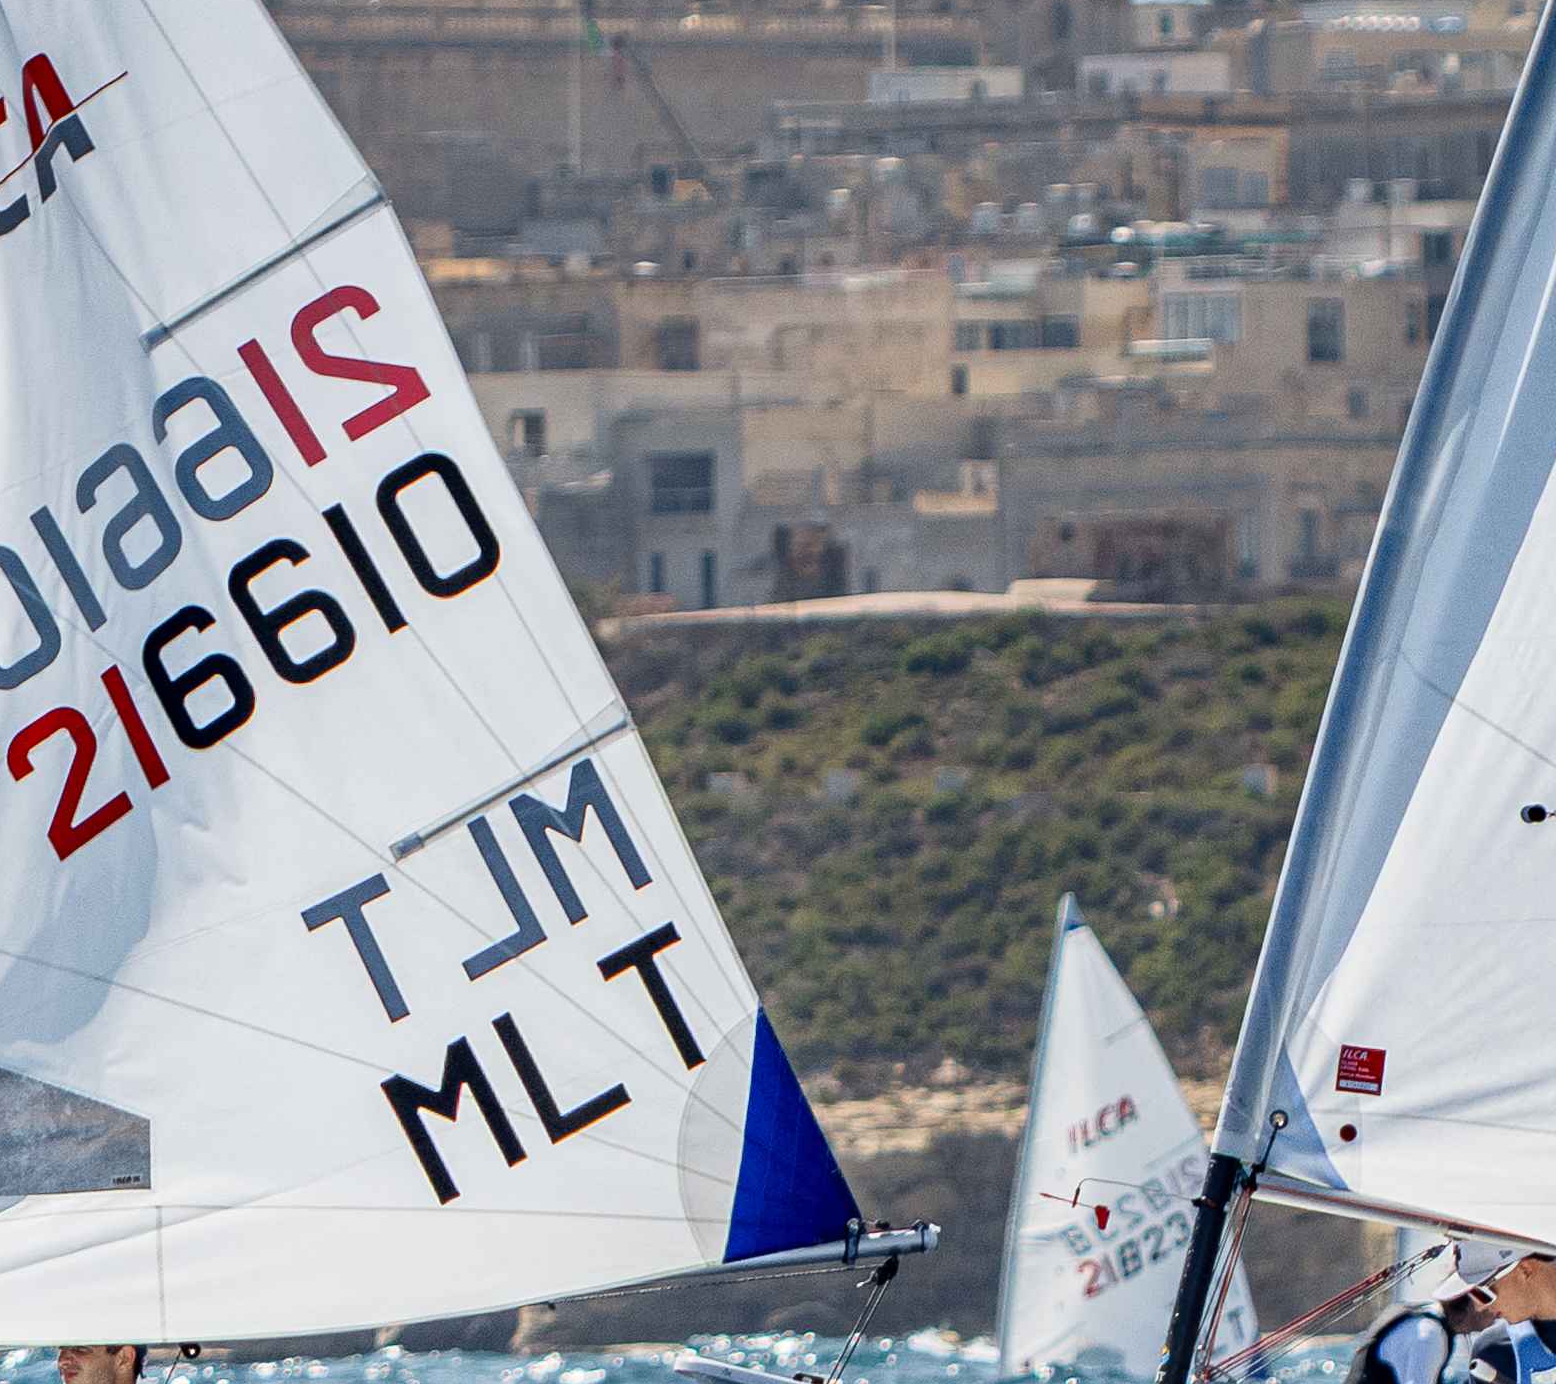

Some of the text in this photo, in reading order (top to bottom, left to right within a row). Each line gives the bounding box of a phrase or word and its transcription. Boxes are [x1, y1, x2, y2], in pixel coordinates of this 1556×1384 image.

[6, 451, 501, 860] 216610
[381, 922, 706, 1204] MLT
[1068, 1096, 1138, 1153] ILCA
